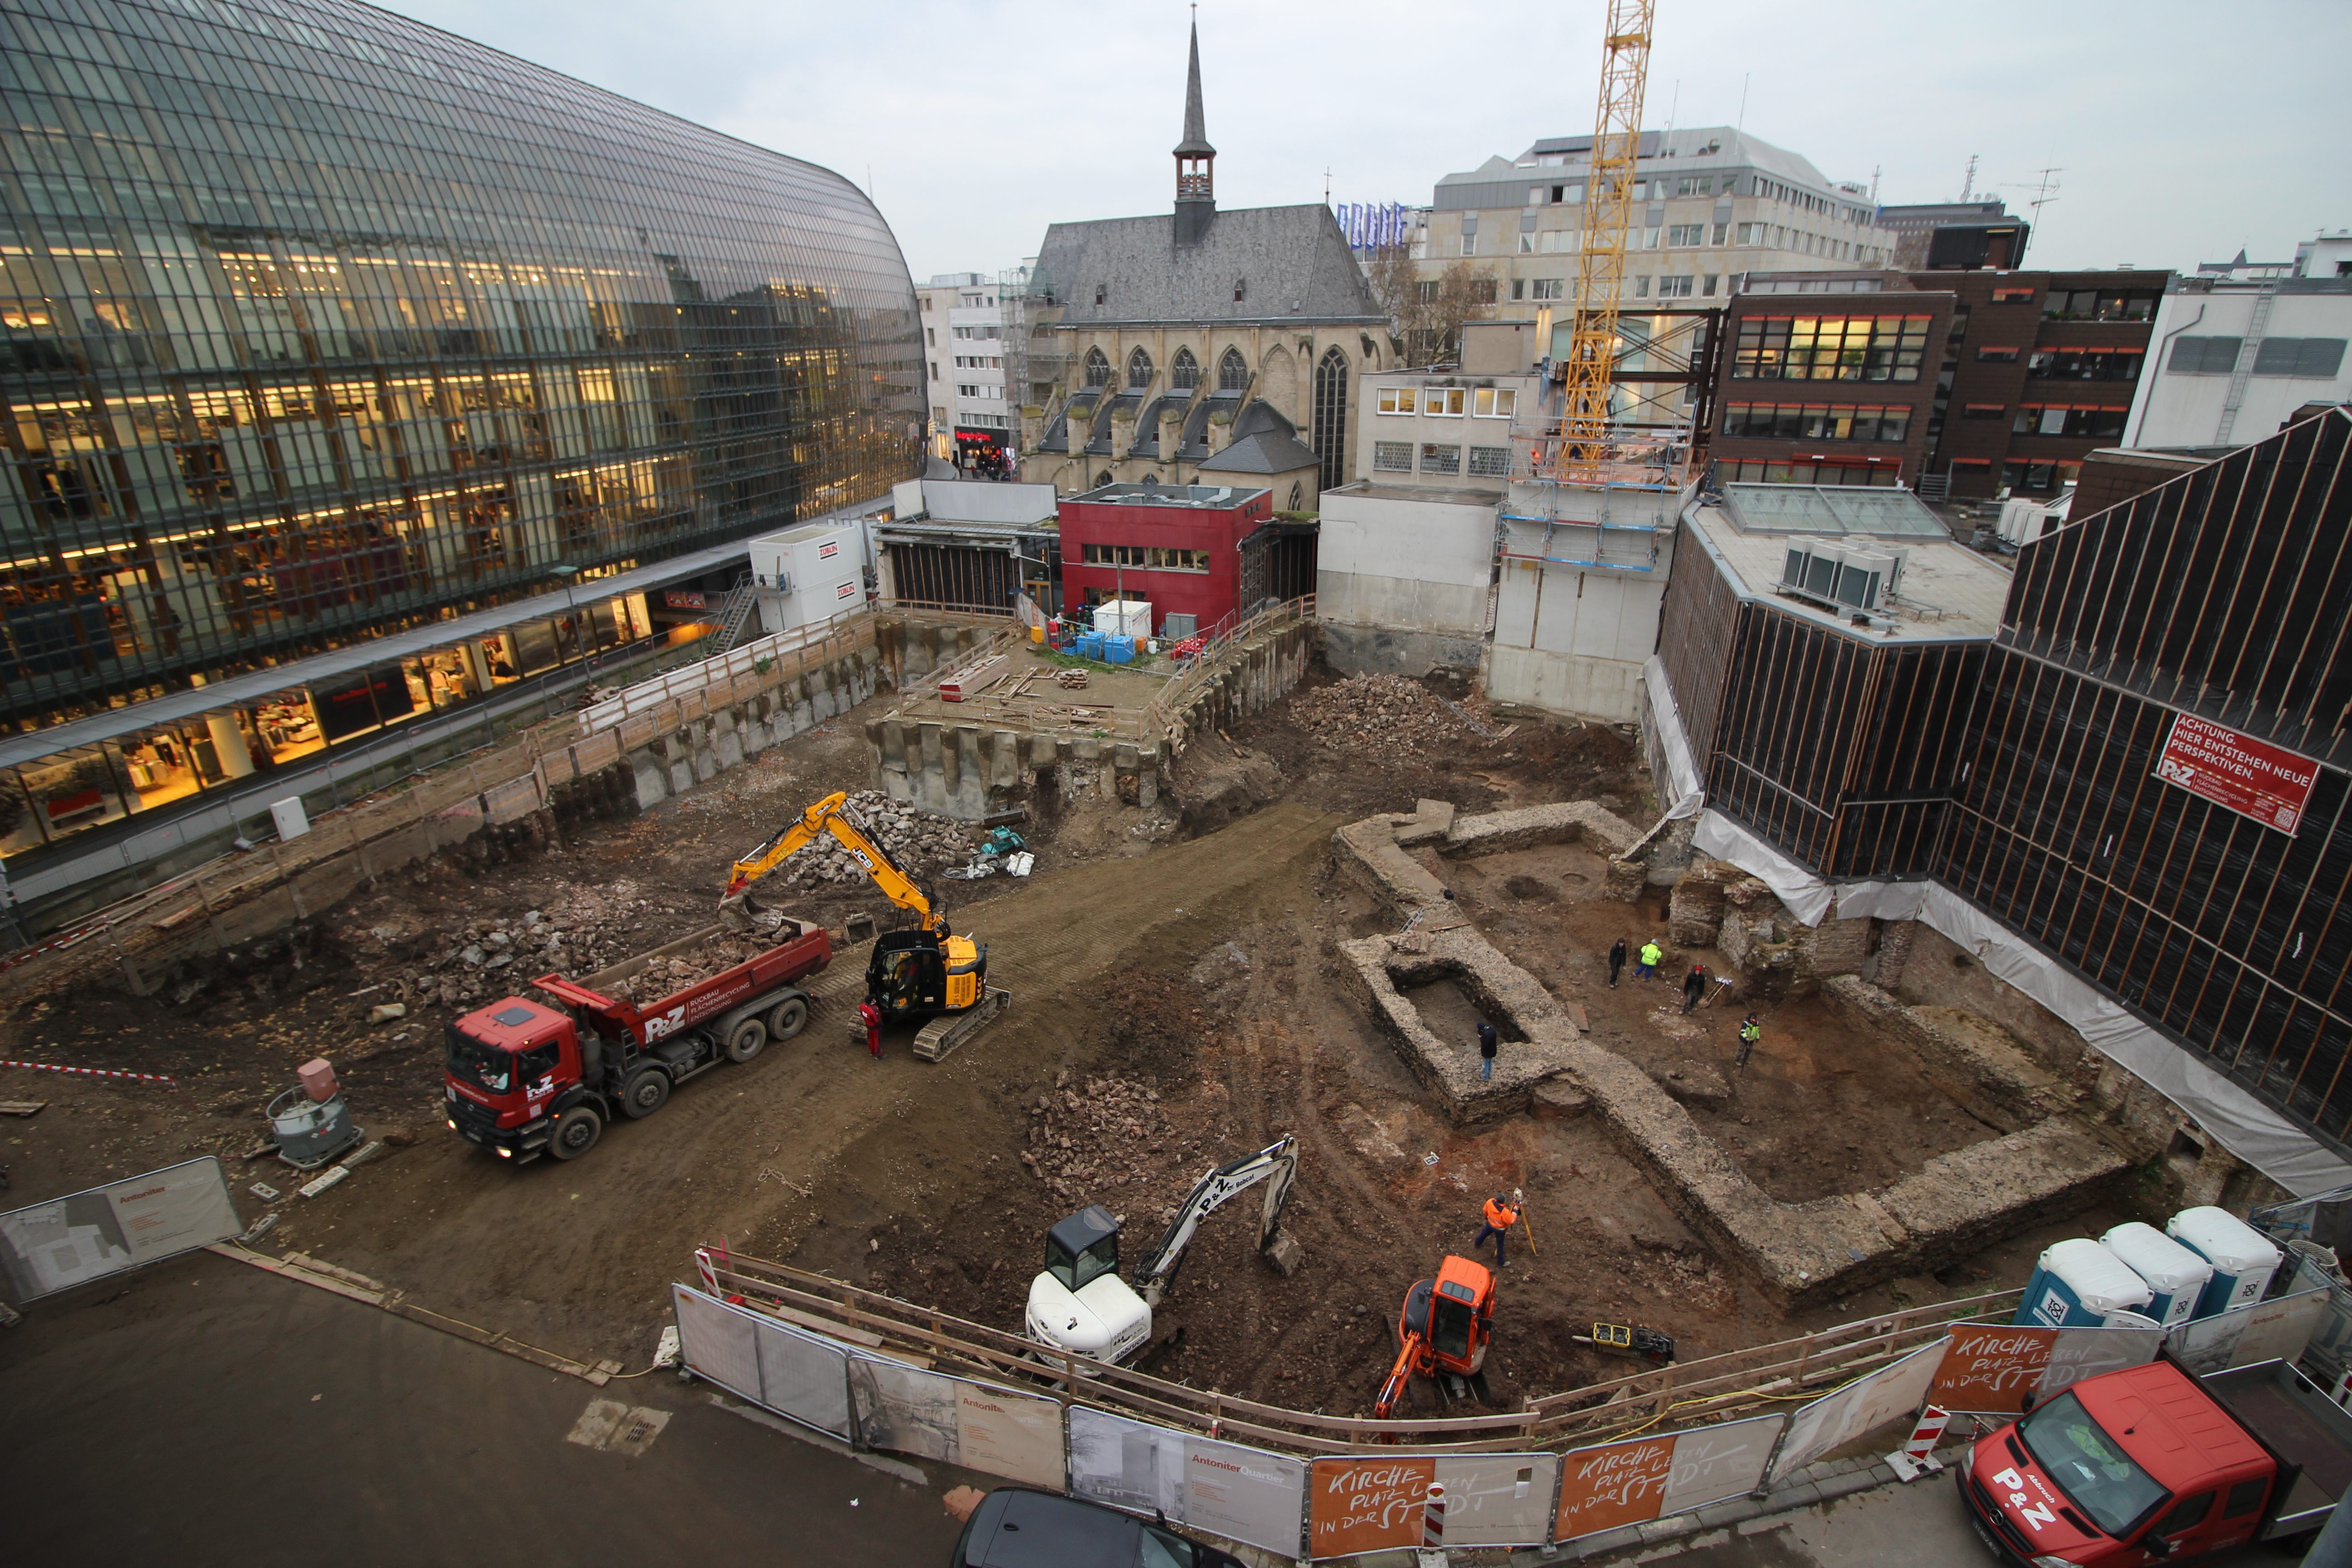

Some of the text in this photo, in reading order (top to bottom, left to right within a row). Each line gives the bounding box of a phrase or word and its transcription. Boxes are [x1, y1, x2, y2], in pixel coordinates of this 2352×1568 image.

[2178, 716, 2236, 745] ACHTUNG.
[2170, 739, 2254, 781] PERSPEKTIVEN.
[2175, 727, 2311, 788] HIER ENTSTEHEN NEUE
[2160, 759, 2195, 787] P&Z
[2198, 772, 2222, 786] RÜCKBAU
[2194, 785, 2229, 803] ENTSORGUNG
[852, 848, 874, 869] JCB
[690, 989, 720, 1007] RÜCKBAU
[690, 998, 732, 1022] ENTSORGUNG
[691, 982, 750, 1014] FLÄCHENRECYCLING
[645, 1004, 686, 1044] P&Z
[1235, 1173, 1254, 1188] Bobcat
[1114, 1336, 1146, 1361] Abbruch
[1970, 1346, 2092, 1372] PLATZ LEBEN
[1049, 1360, 1065, 1370] Zaum
[1939, 1357, 2127, 1391] IN DER STADT
[1594, 1466, 1645, 1491] PLATZ
[1651, 1441, 1714, 1472] LEBEN
[1564, 1503, 1580, 1517] IN
[1585, 1489, 1618, 1509] DER
[1617, 1444, 1748, 1505] STADT
[2026, 1474, 2055, 1504] Abbruch
[1320, 1520, 1335, 1534] IN
[1341, 1511, 1377, 1529] DER
[1378, 1485, 1517, 1529] STDT
[1350, 1489, 1405, 1511] PLATZ
